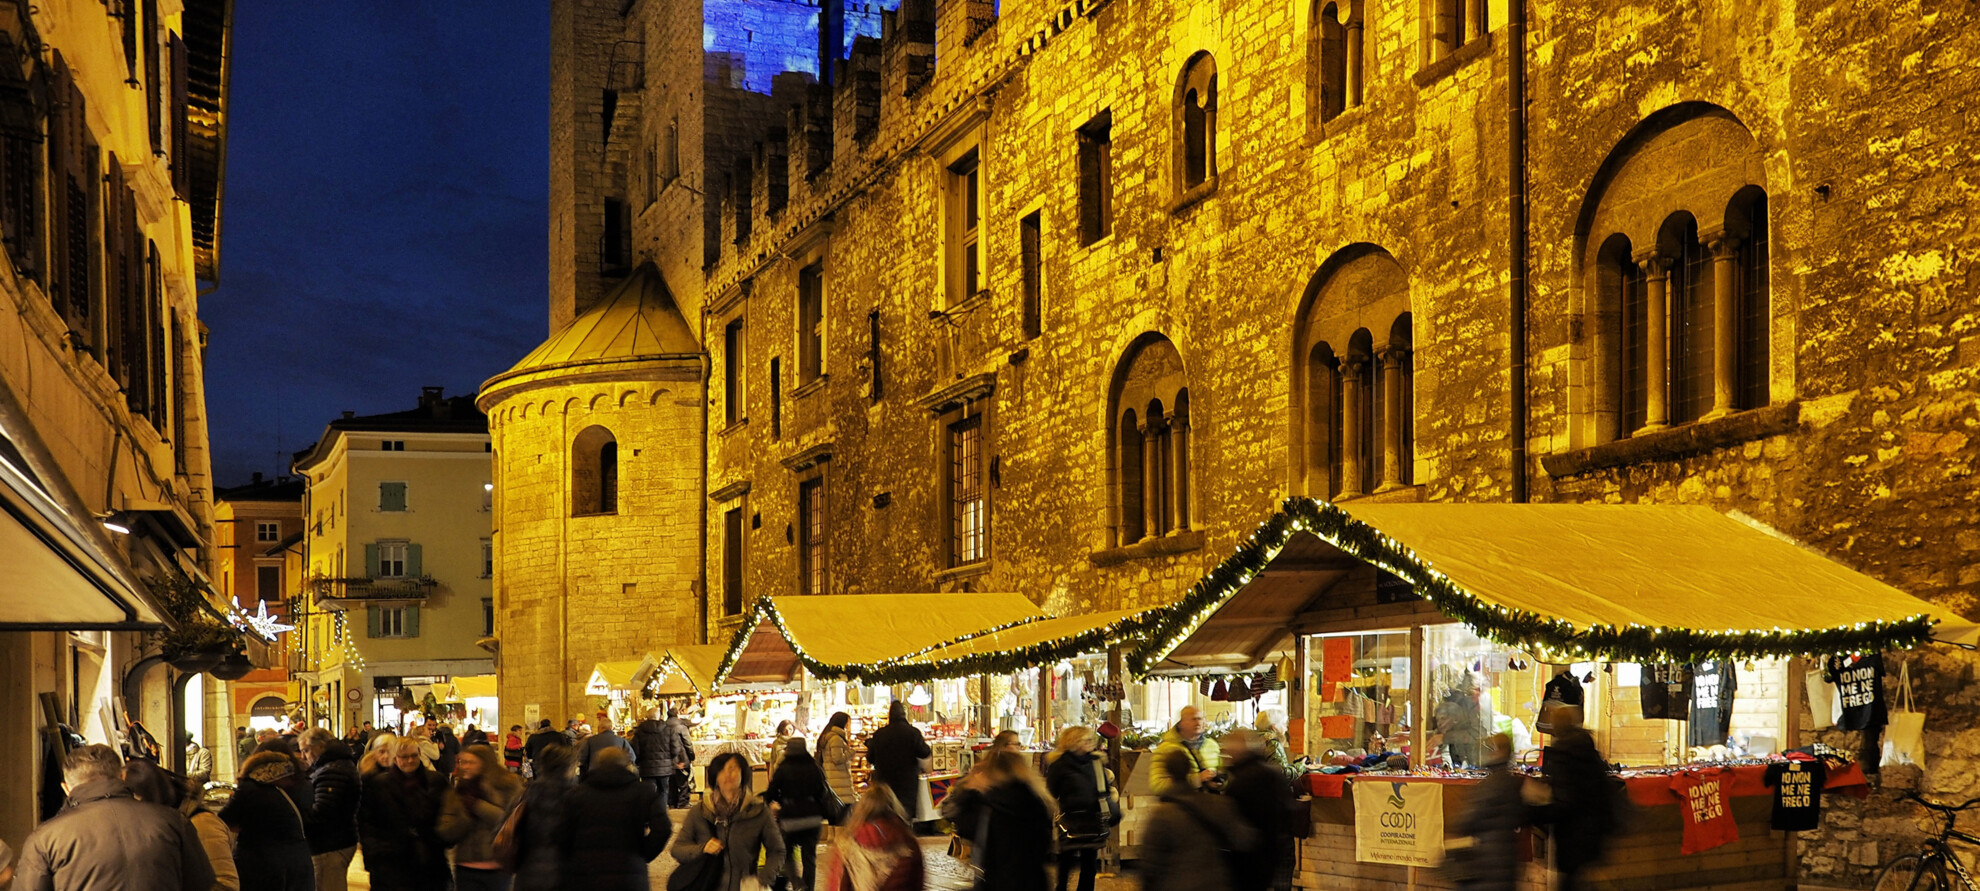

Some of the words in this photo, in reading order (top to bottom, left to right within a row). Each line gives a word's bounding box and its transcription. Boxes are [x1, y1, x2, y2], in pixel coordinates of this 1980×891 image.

[1840, 671, 1851, 683] IO
[1852, 666, 1875, 682] NON
[1841, 683, 1858, 696] ME
[1861, 679, 1874, 692] NE
[1696, 697, 1718, 709] FREG
[1842, 692, 1875, 708] FREGO
[1782, 772, 1791, 784] IO
[1792, 772, 1811, 784] NON
[1689, 786, 1699, 798] IO
[1701, 780, 1720, 795] NON
[1781, 784, 1794, 796] ME
[1797, 784, 1811, 795] NE
[1691, 798, 1705, 811] ME
[1707, 792, 1721, 807] NE
[1782, 796, 1810, 808] FREGO
[1380, 812, 1416, 832] COOPI
[1694, 805, 1723, 824] FREGO
[1380, 832, 1416, 840] COOPERAZIONE
